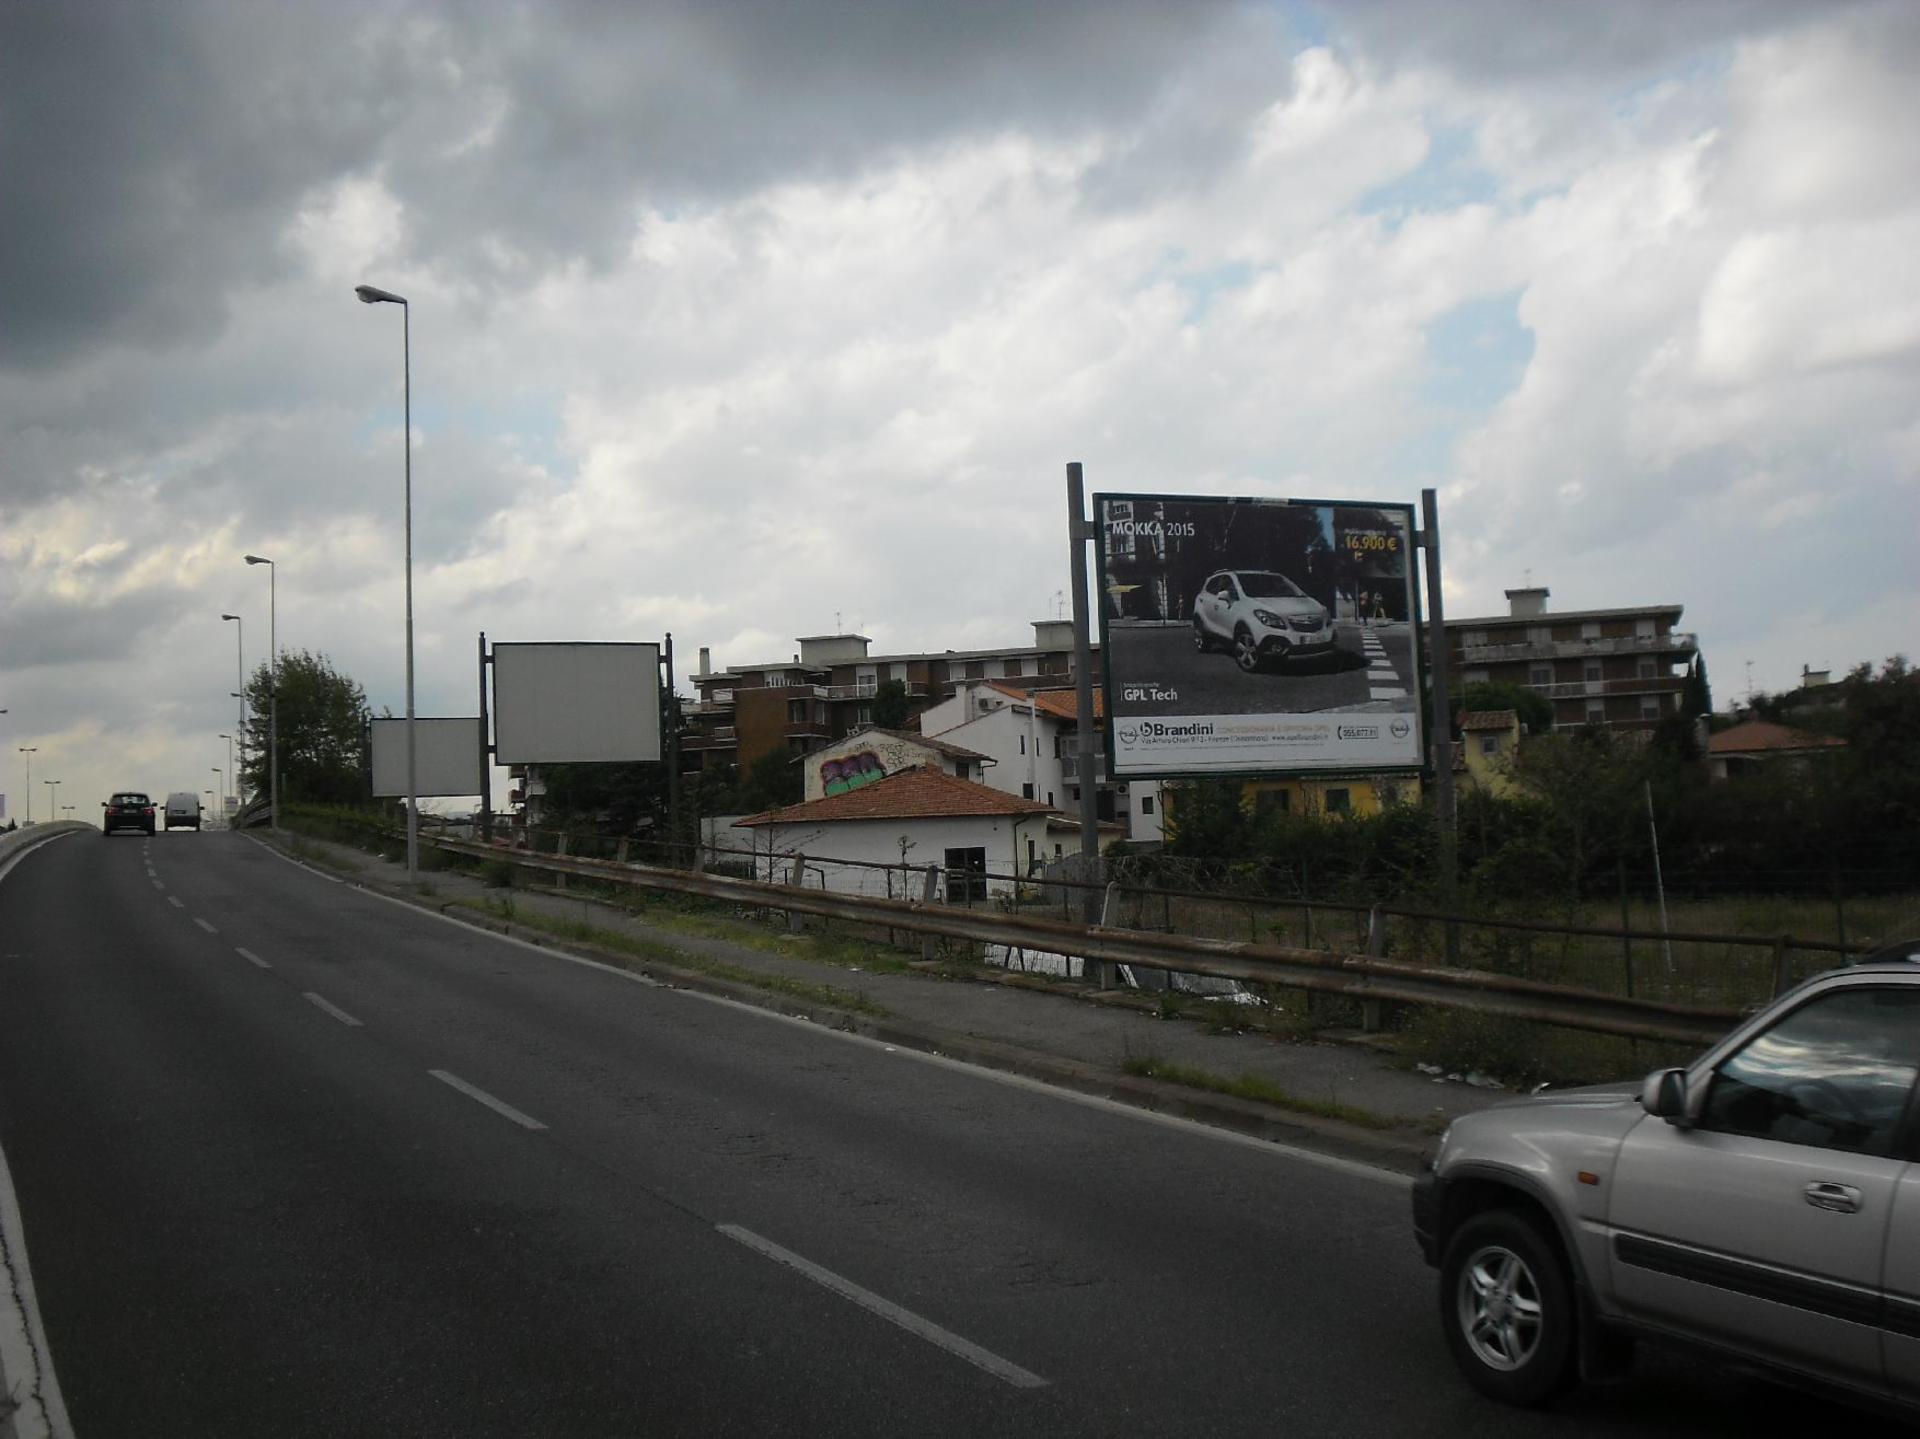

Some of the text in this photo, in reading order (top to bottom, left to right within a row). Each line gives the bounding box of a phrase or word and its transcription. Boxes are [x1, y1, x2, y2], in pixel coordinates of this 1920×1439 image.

[1112, 521, 1195, 537] MOKKA 2015
[1346, 535, 1398, 552] 16.900 €
[1124, 687, 1178, 701] GPL Tech
[1153, 722, 1214, 736] Brandini
